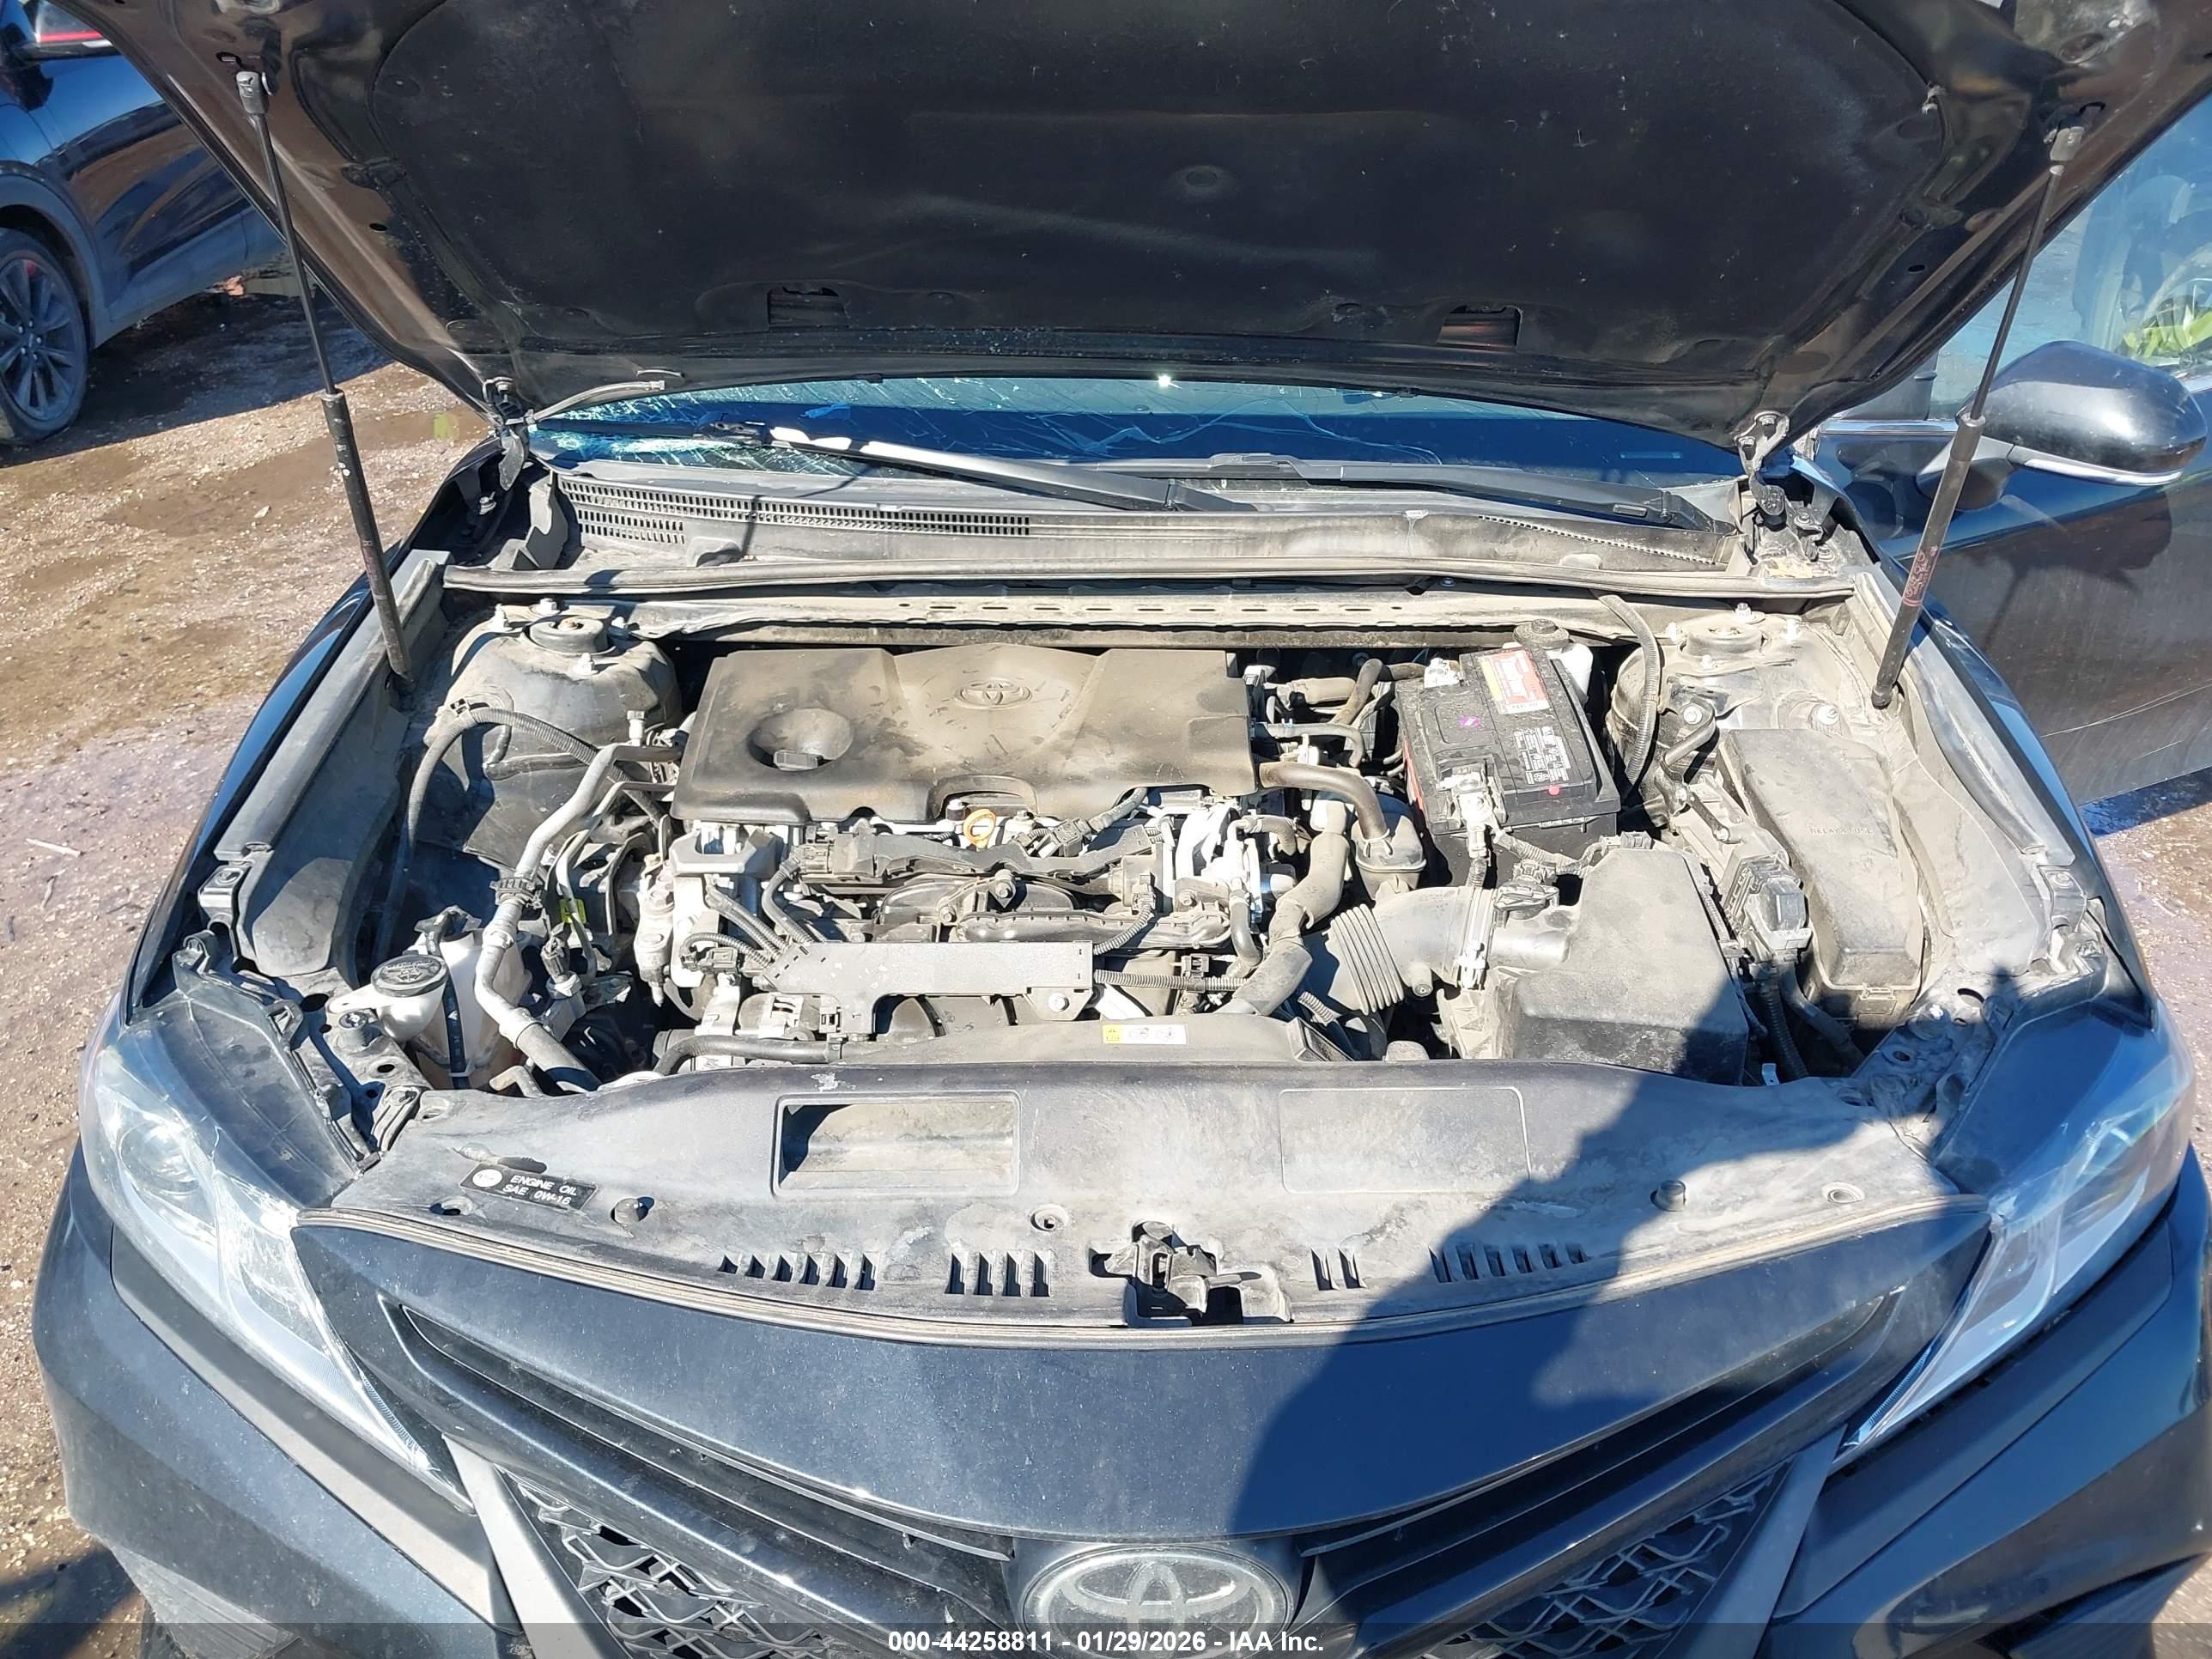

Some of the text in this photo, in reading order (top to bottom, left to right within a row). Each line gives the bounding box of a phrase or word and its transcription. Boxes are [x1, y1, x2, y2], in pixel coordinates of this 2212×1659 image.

[501, 1183, 572, 1206] SAE 0W-16
[510, 1175, 556, 1190] ENGINE
[559, 1185, 578, 1196] OIL
